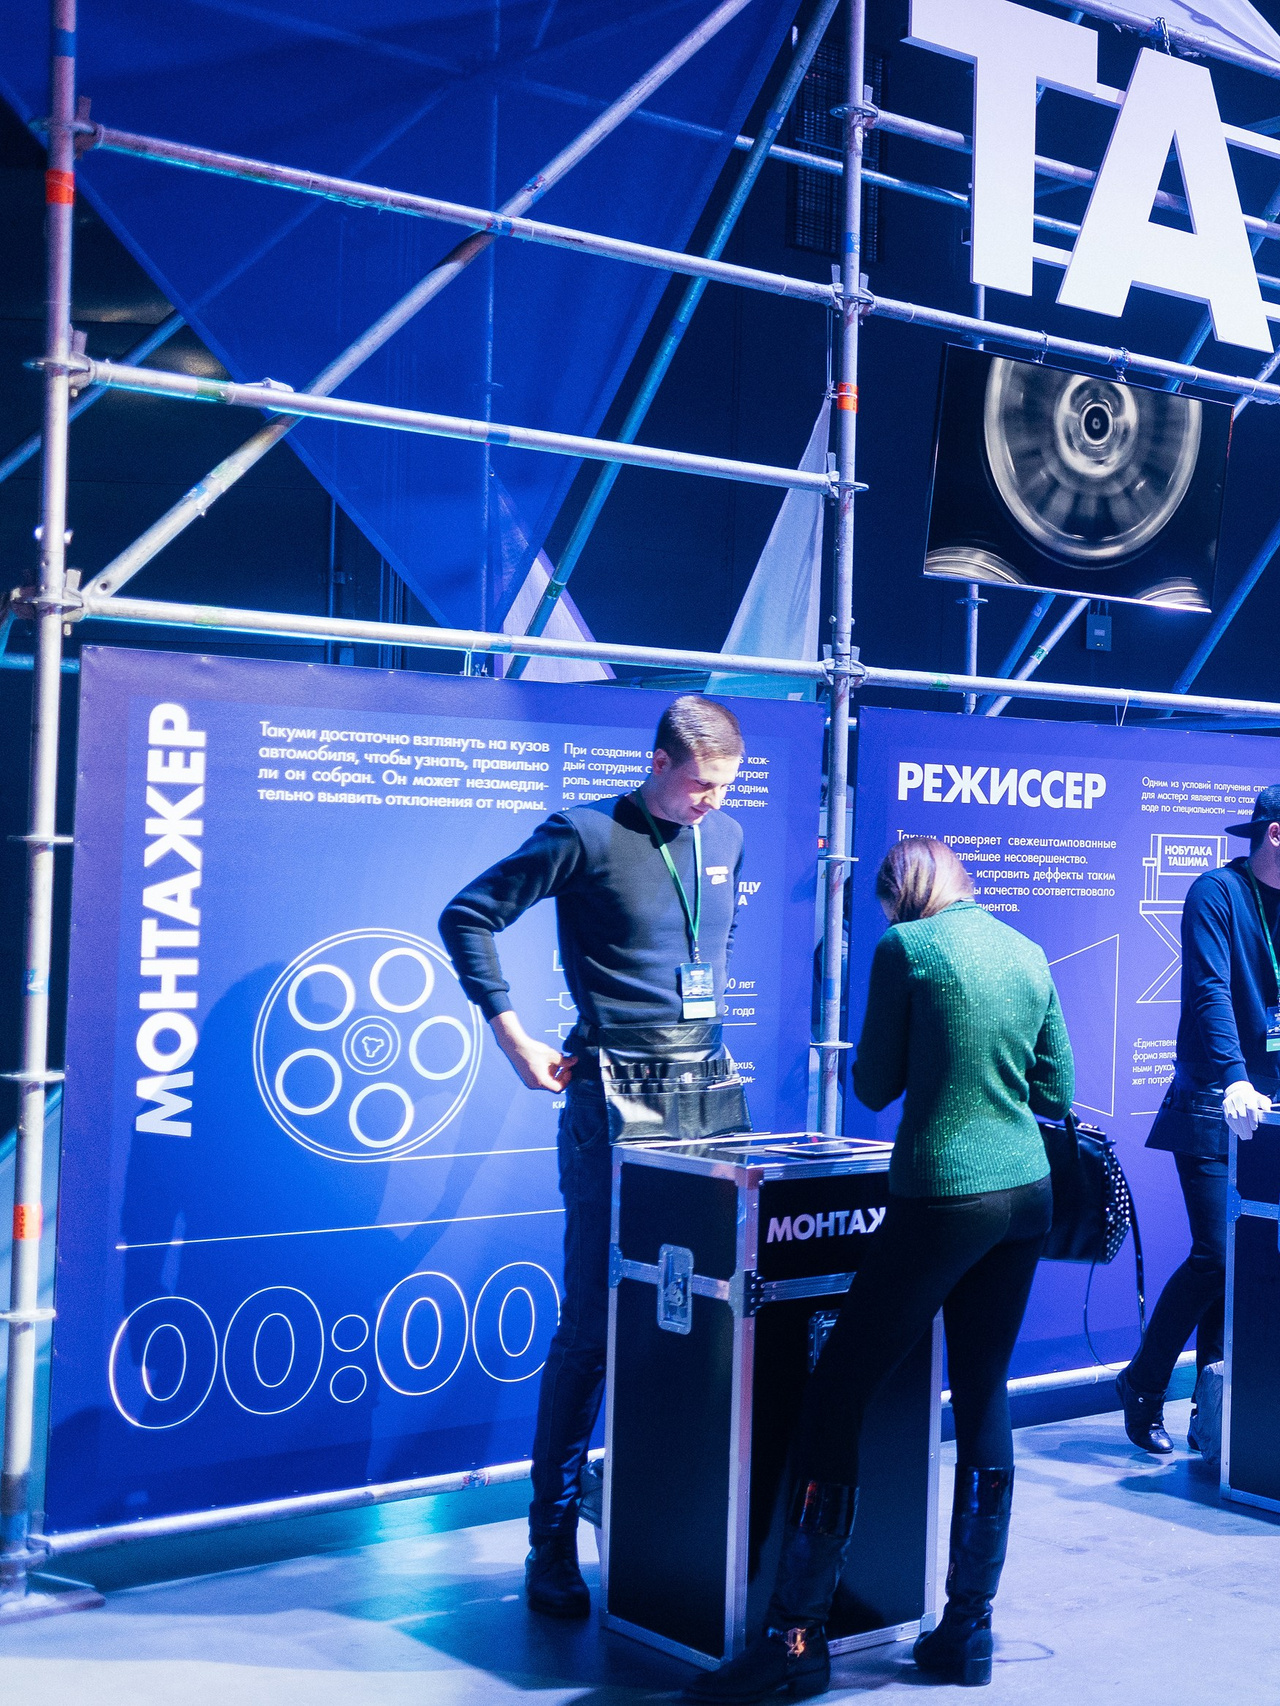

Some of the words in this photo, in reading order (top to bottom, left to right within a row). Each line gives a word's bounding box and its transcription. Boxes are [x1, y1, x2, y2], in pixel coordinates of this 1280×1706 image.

[259, 721, 316, 742] Такуми
[320, 729, 409, 746] достаточно
[413, 735, 485, 752] взглянуть
[489, 740, 507, 750] на
[510, 741, 550, 755] кузов
[563, 742, 587, 758] При
[591, 747, 642, 759] создании
[259, 745, 359, 764] автомобиля,
[364, 749, 411, 766] чтобы
[414, 754, 468, 771] узнать,
[473, 757, 549, 773] правильно
[747, 756, 770, 765] каж-
[562, 759, 586, 771] дый
[587, 762, 643, 775] сотрудник
[258, 767, 278, 780] ли
[285, 769, 305, 780] он
[312, 766, 375, 787] собран.
[382, 770, 406, 785] Он
[413, 775, 460, 788] может
[466, 778, 549, 793] незамедли-
[562, 776, 590, 788] роль
[897, 761, 1107, 809] РЕЖИССЕР
[1142, 776, 1168, 788] Одним
[1181, 780, 1211, 791] условий
[1214, 782, 1251, 793] получения
[737, 784, 769, 794] одним
[257, 788, 313, 802] тельно
[318, 791, 382, 805] выявить
[385, 794, 472, 808] отклонения
[476, 798, 493, 809] от
[497, 799, 547, 813] нормы.
[562, 792, 575, 800] из
[1141, 792, 1155, 800] для
[1157, 793, 1188, 803] мастера
[1190, 794, 1222, 803] является
[1224, 795, 1236, 803] его
[1238, 796, 1255, 804] стаж
[1141, 804, 1159, 812] воде
[1172, 805, 1225, 815] специальности
[943, 835, 1002, 848] проверяет
[1008, 836, 1117, 850] свежештампованные
[1164, 845, 1213, 856] НОБУТАКА
[1004, 853, 1088, 865] несовершенство.
[1168, 856, 1209, 867] ТАШИМА
[976, 869, 1030, 882] исправить
[1033, 867, 1084, 884] деффекты
[1087, 871, 1116, 881] таким
[984, 885, 1030, 897] качество
[1032, 887, 1116, 898] соответствовало
[135, 702, 206, 1138] МОНТАЖЕР
[738, 980, 756, 989] лет
[732, 1007, 755, 1017] года
[1132, 1050, 1158, 1063] форма
[1132, 1065, 1153, 1073] ными
[109, 1261, 561, 1429] 00:00
